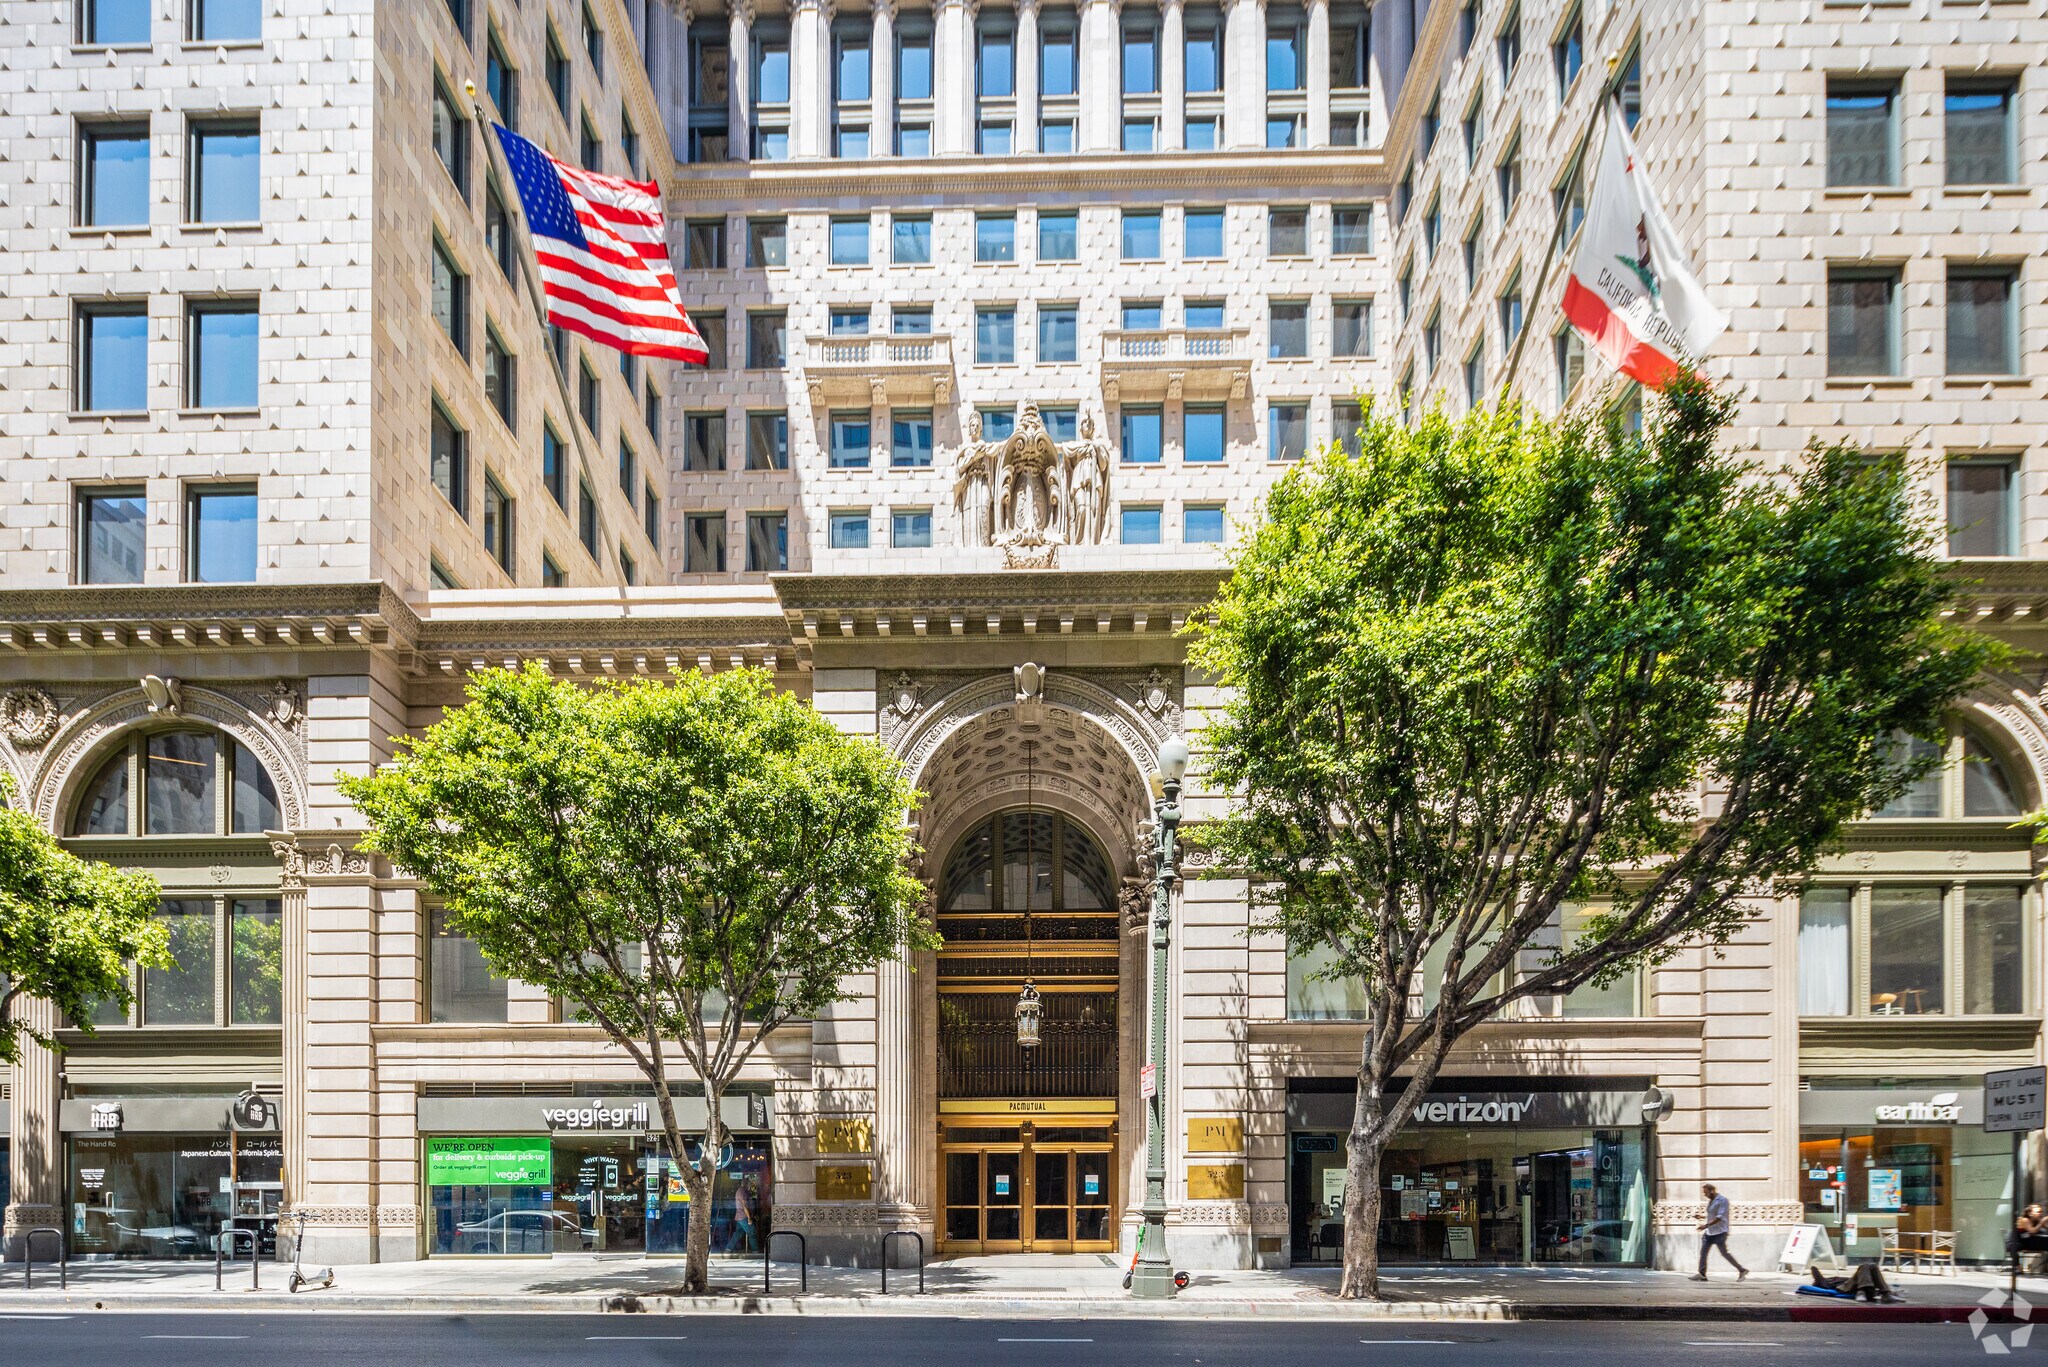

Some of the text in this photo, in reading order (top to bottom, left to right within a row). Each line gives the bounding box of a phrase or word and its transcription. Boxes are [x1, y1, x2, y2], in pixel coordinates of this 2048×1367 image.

[1988, 1077, 2043, 1090] LEFT LANE
[1993, 1094, 2036, 1106] MUST
[1009, 1103, 1046, 1111] PACMUTUAL
[1413, 1096, 1520, 1122] verizon
[1875, 1102, 1963, 1120] earthbar
[250, 1110, 263, 1121] HRB
[542, 1100, 647, 1127] veggiegrill
[1987, 1111, 2042, 1122] TURN LEFT
[91, 1112, 120, 1128] HRB
[834, 1127, 853, 1137] PM
[1206, 1126, 1225, 1136] PM
[433, 1143, 494, 1151] WE'RE OPEN
[181, 1150, 208, 1158] Japanese
[445, 1153, 475, 1162] delivery
[518, 1153, 545, 1162] pick-up
[584, 1156, 618, 1164] WHY WAIT?
[495, 1167, 546, 1181] veggiegrill
[561, 1193, 592, 1202] veggiegrill
[605, 1193, 637, 1202] veggiegrill
